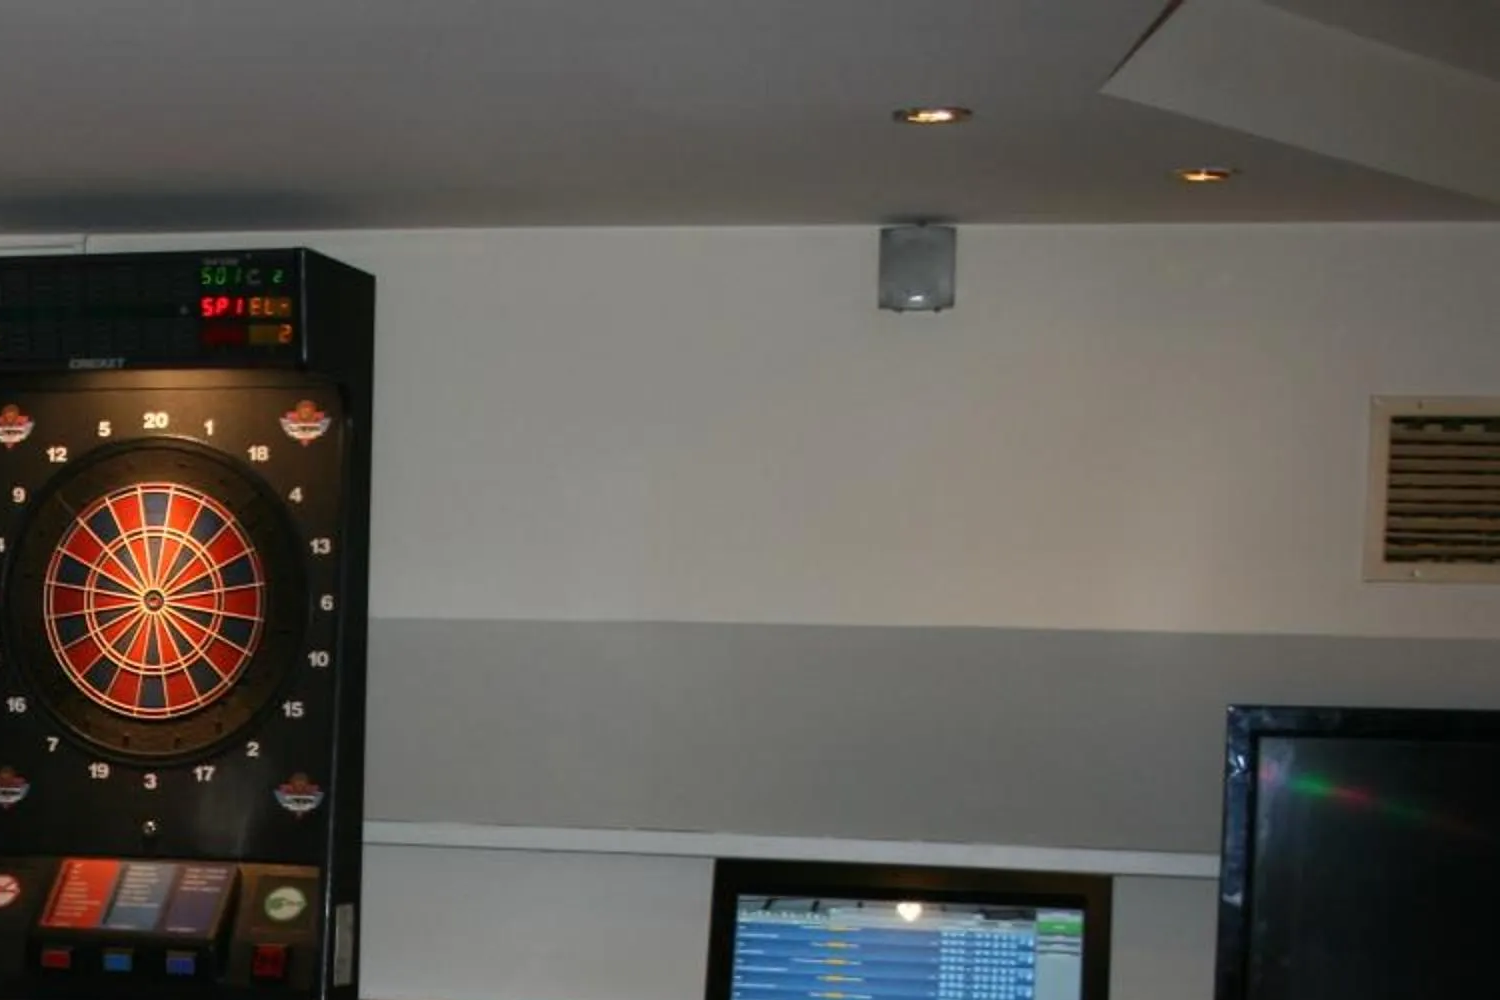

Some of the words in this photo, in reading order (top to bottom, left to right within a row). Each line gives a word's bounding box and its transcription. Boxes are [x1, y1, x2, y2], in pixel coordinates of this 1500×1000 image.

[143, 411, 170, 429] 20
[203, 419, 214, 436] 1
[98, 420, 112, 438] 5
[46, 446, 68, 463] 12
[247, 445, 269, 462] 18
[12, 487, 26, 503] 9
[289, 487, 303, 503] 4
[309, 538, 331, 555] 13
[320, 594, 334, 611] 6
[307, 650, 330, 667] 10
[6, 696, 27, 713] 16
[282, 701, 304, 718] 15
[46, 736, 59, 753] 7
[246, 741, 260, 757] 2
[88, 762, 110, 779] 19
[194, 765, 216, 782] 17
[143, 773, 157, 790] 3
